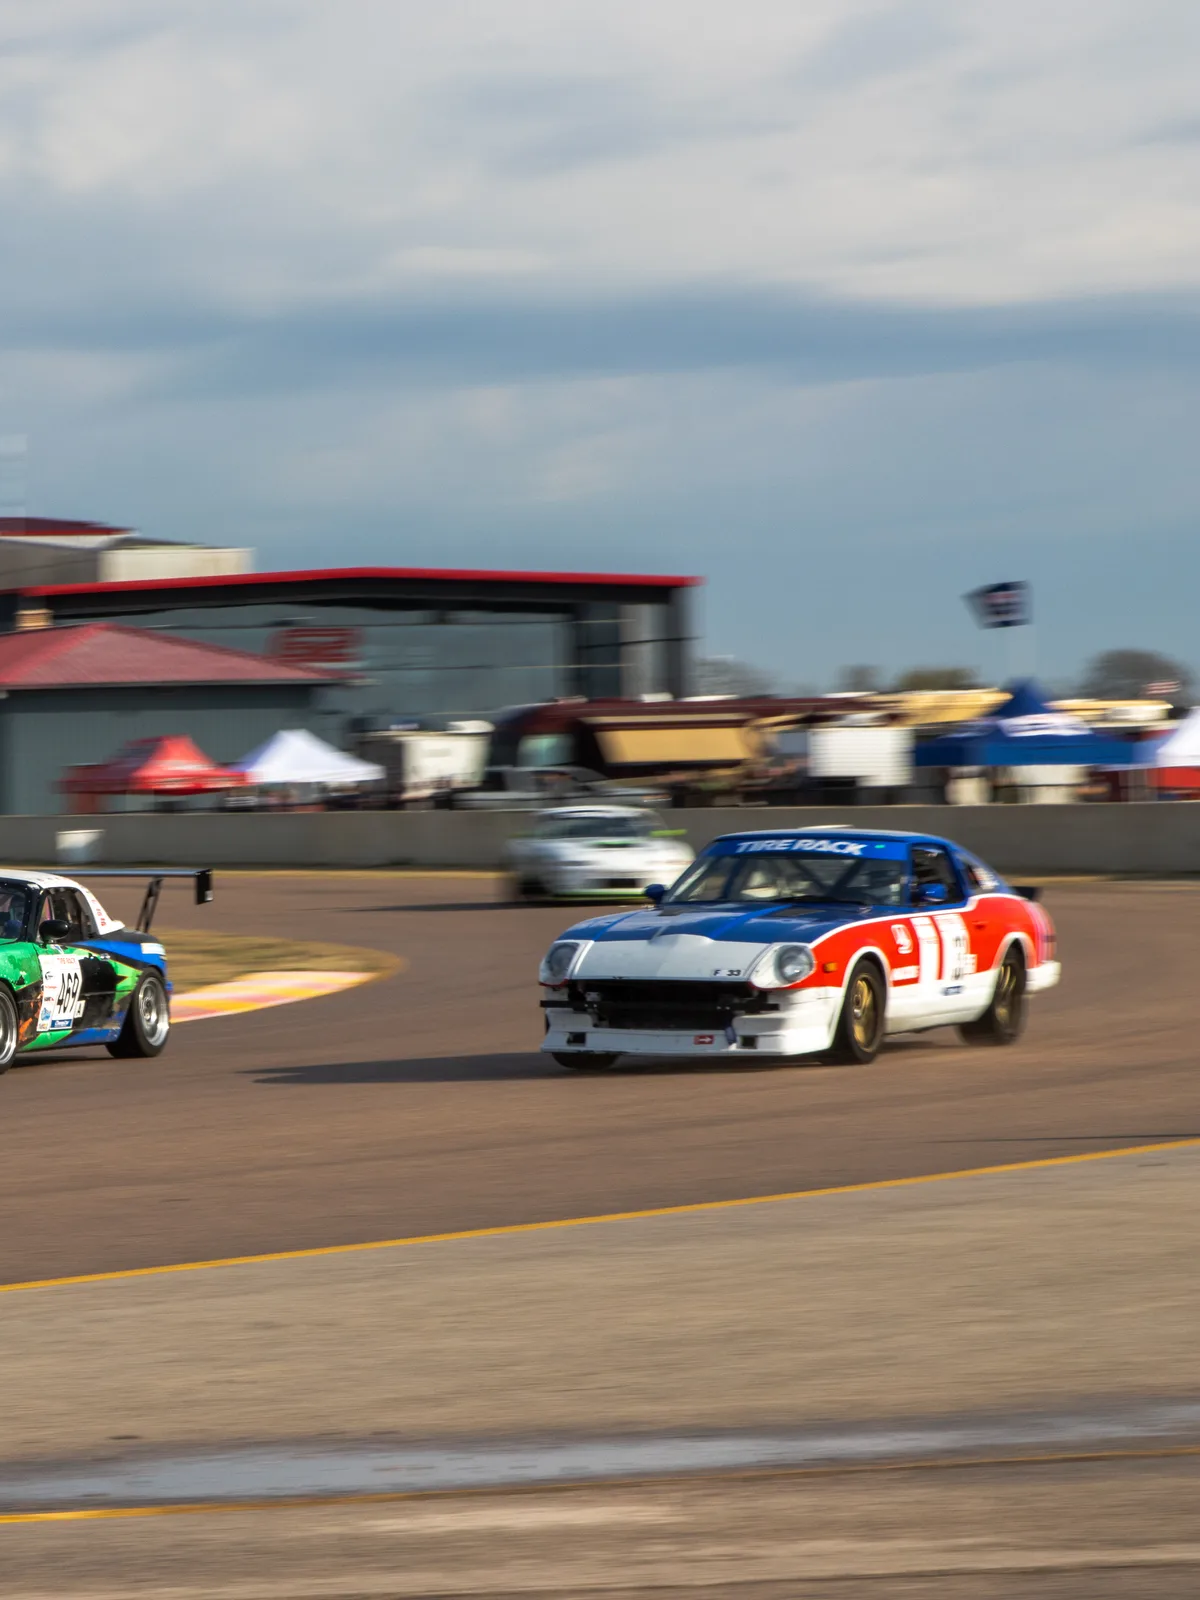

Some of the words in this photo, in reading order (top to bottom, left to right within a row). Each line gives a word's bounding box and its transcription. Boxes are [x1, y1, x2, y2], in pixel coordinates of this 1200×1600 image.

[735, 839, 797, 854] TIRE
[792, 839, 867, 856] RACK
[56, 972, 80, 1015] 469
